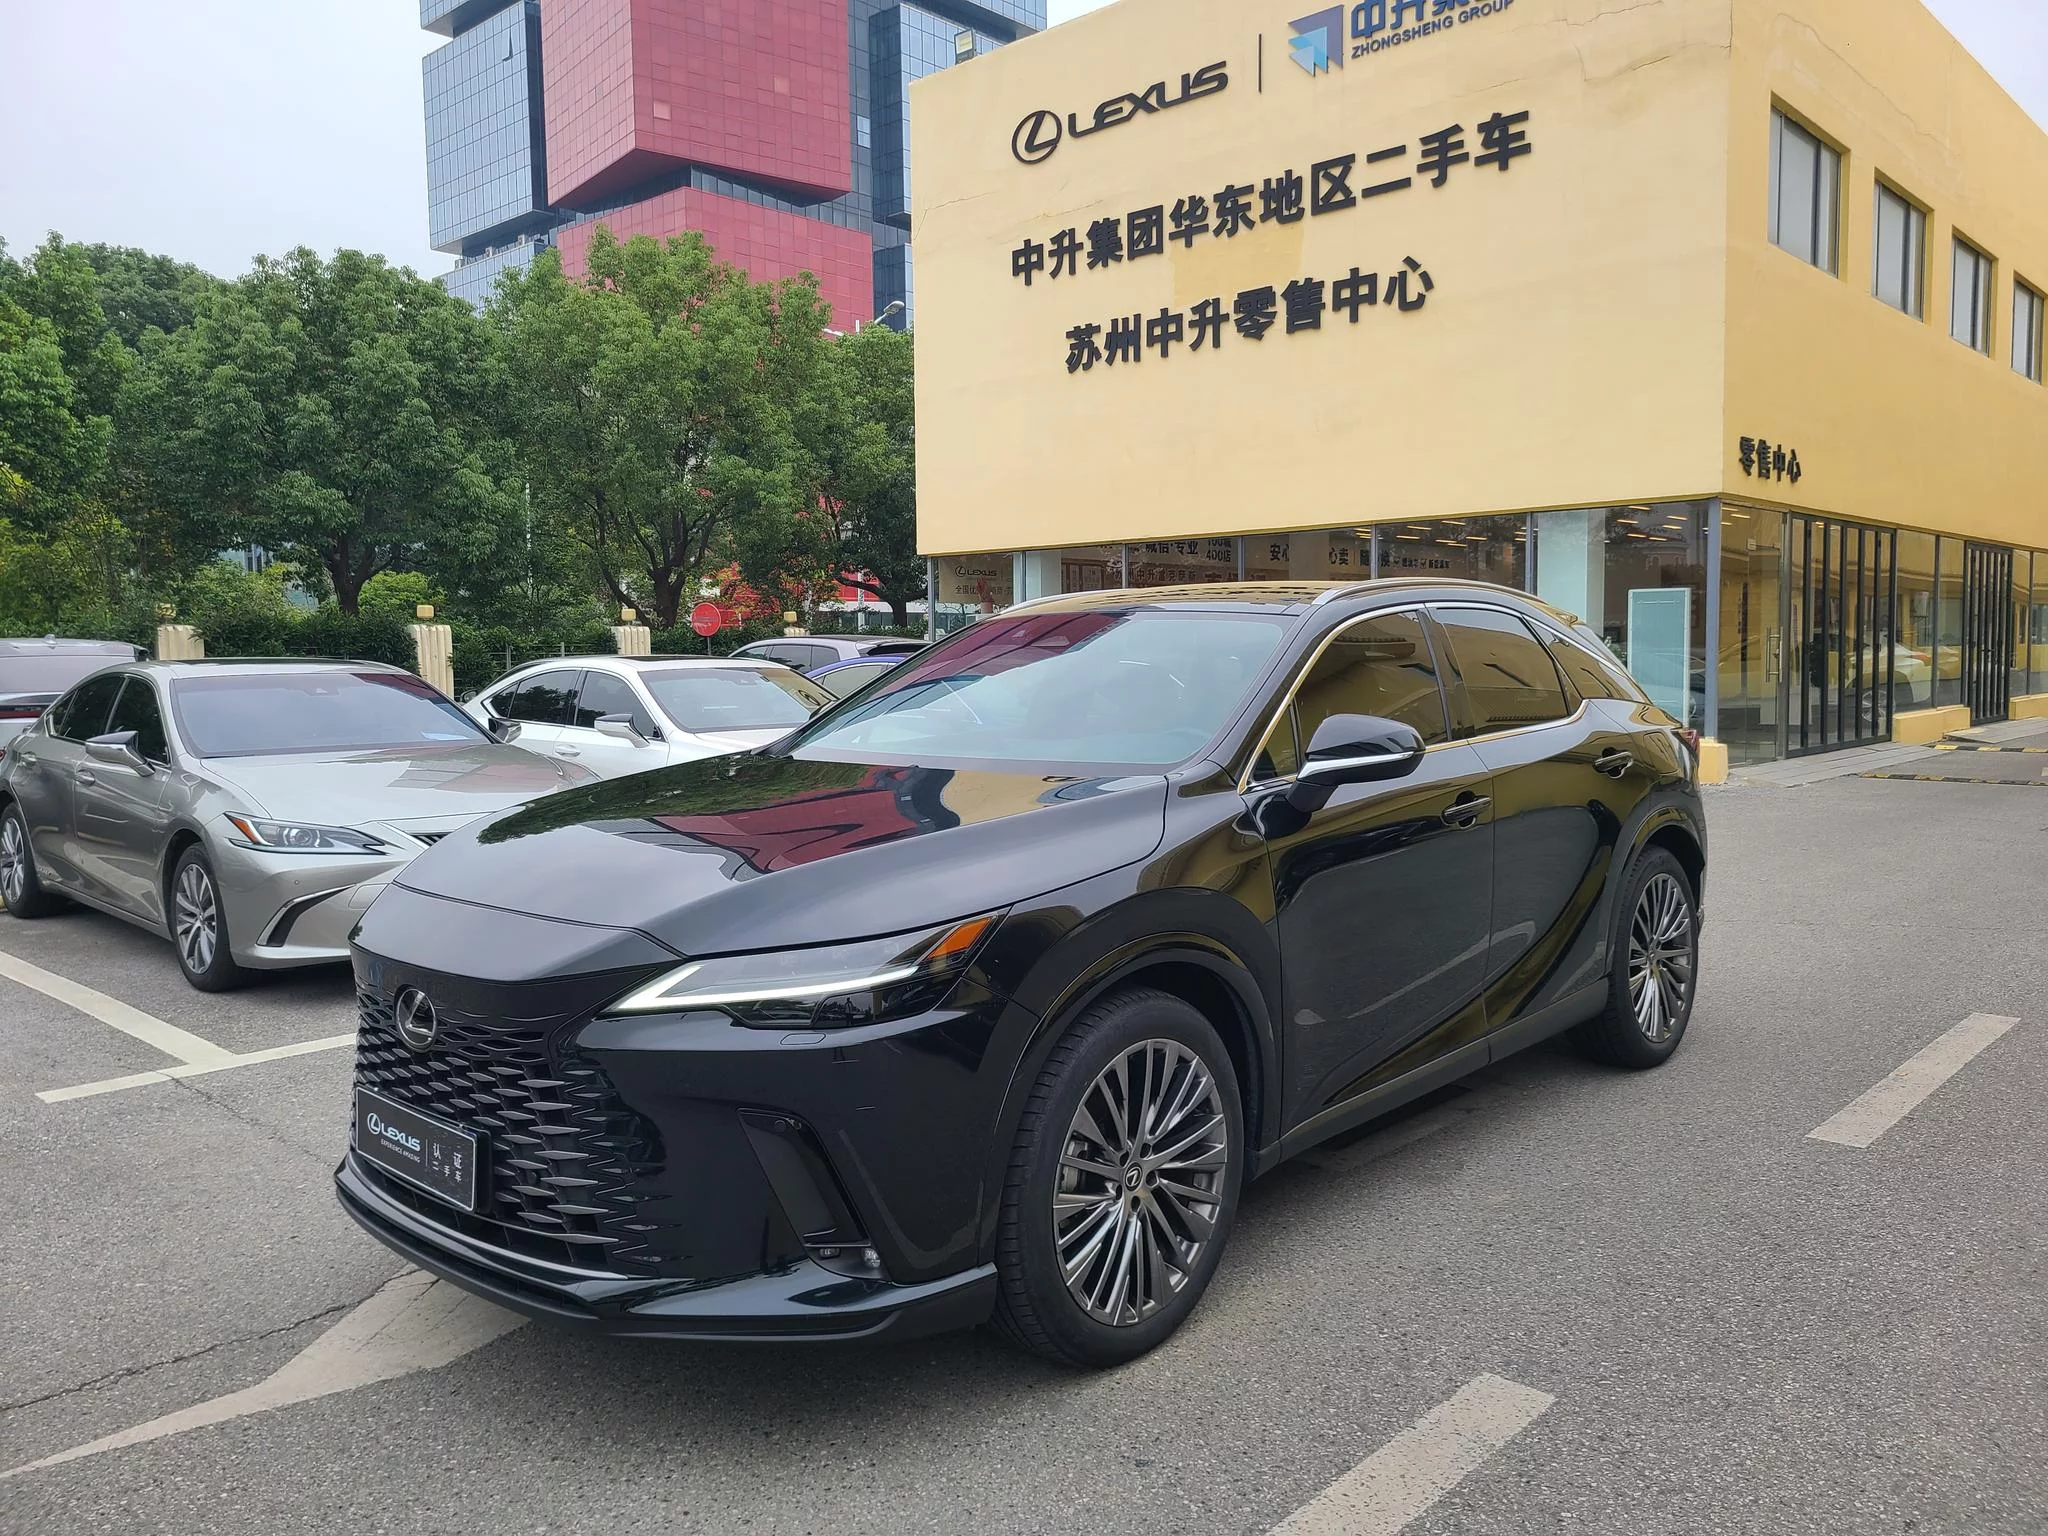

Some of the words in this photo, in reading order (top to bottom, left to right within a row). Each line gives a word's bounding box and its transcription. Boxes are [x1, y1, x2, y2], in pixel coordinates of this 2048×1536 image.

[1350, 0, 1488, 39] 中升
[1351, 16, 1454, 60] ZHONGSHENG
[1457, 0, 1517, 24] GROUP
[1068, 60, 1229, 138] LEXUS
[1011, 109, 1532, 287] 中升集团华东地区二手车
[1064, 255, 1435, 375] 苏州中升零售中心
[1738, 435, 1802, 484] 零售中心
[967, 569, 999, 577] LEXUS
[380, 1138, 403, 1156] EXPERIENCE
[402, 1150, 420, 1164] AMAZING
[381, 1122, 421, 1152] LEXUS
